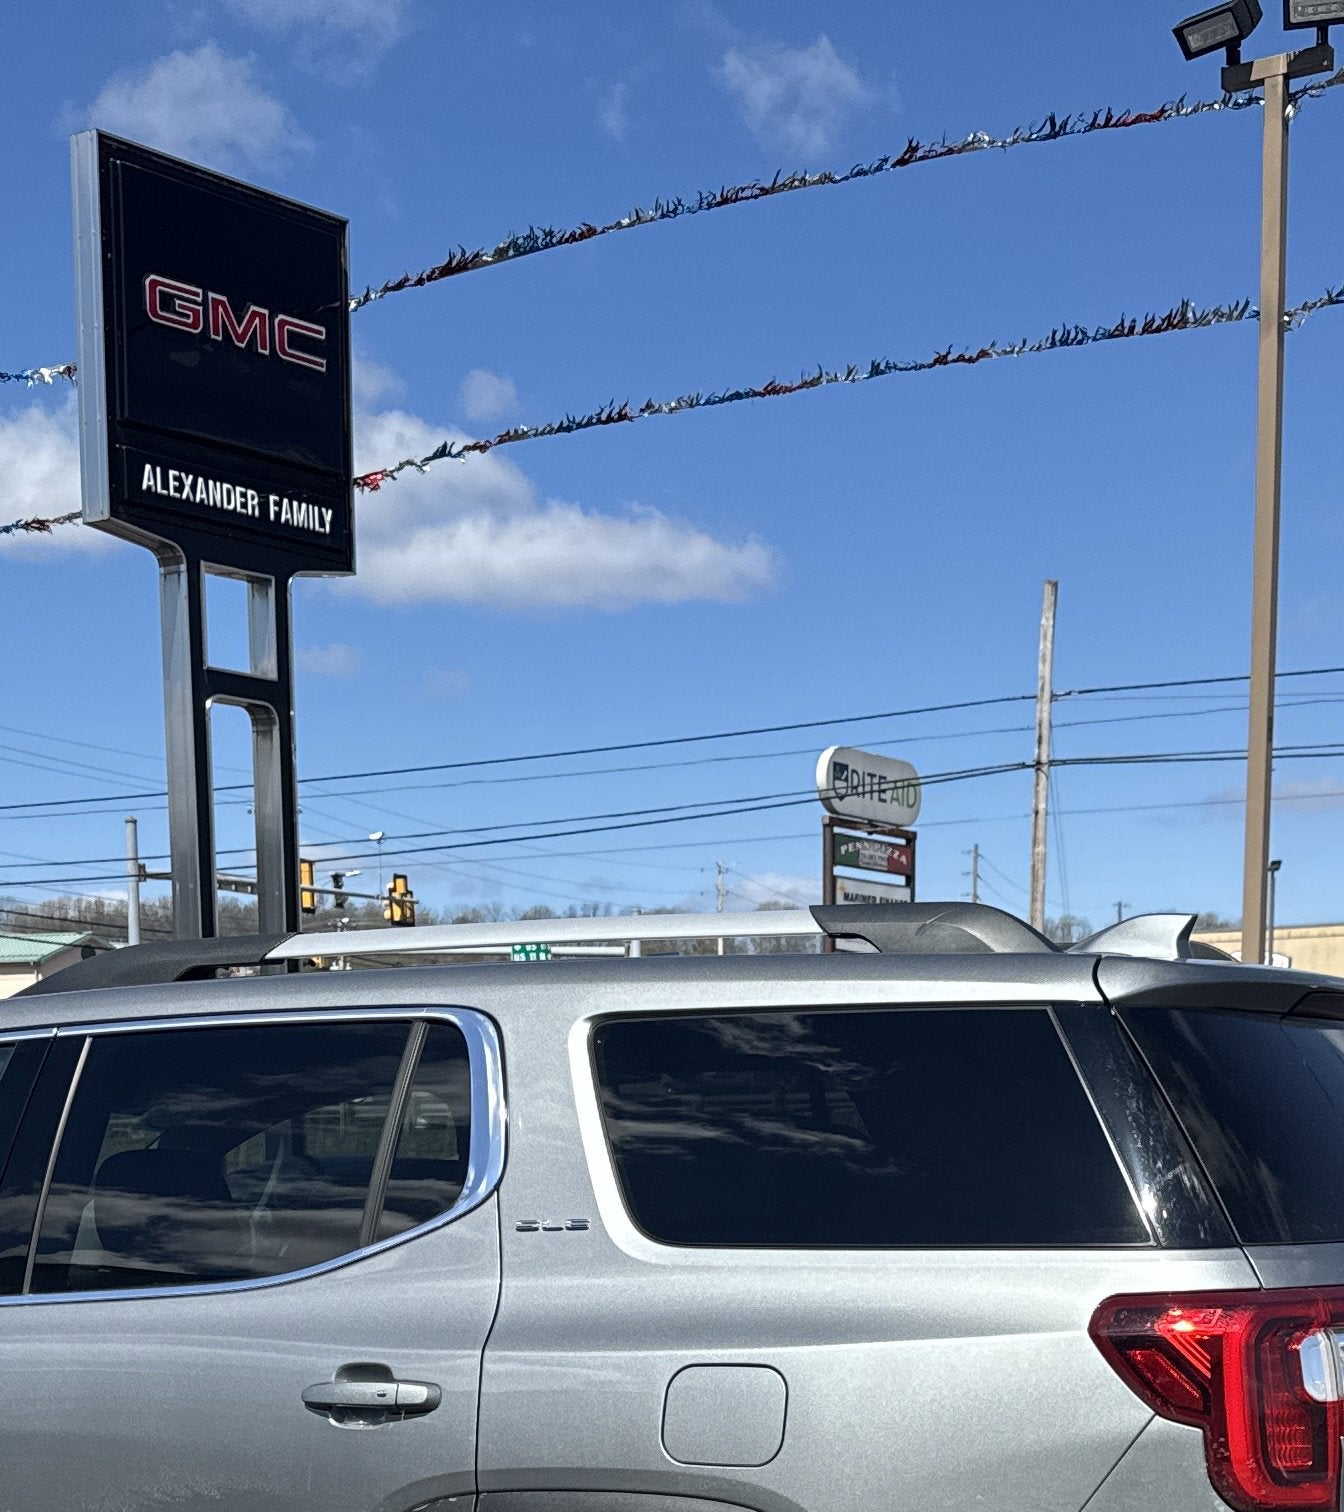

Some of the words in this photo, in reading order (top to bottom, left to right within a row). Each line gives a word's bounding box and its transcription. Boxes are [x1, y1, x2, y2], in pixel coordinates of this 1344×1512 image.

[145, 274, 327, 373] GMC
[141, 463, 260, 519] ALEXANDER
[268, 494, 334, 535] FAMILY
[849, 768, 888, 804] RITE
[889, 781, 918, 809] AID
